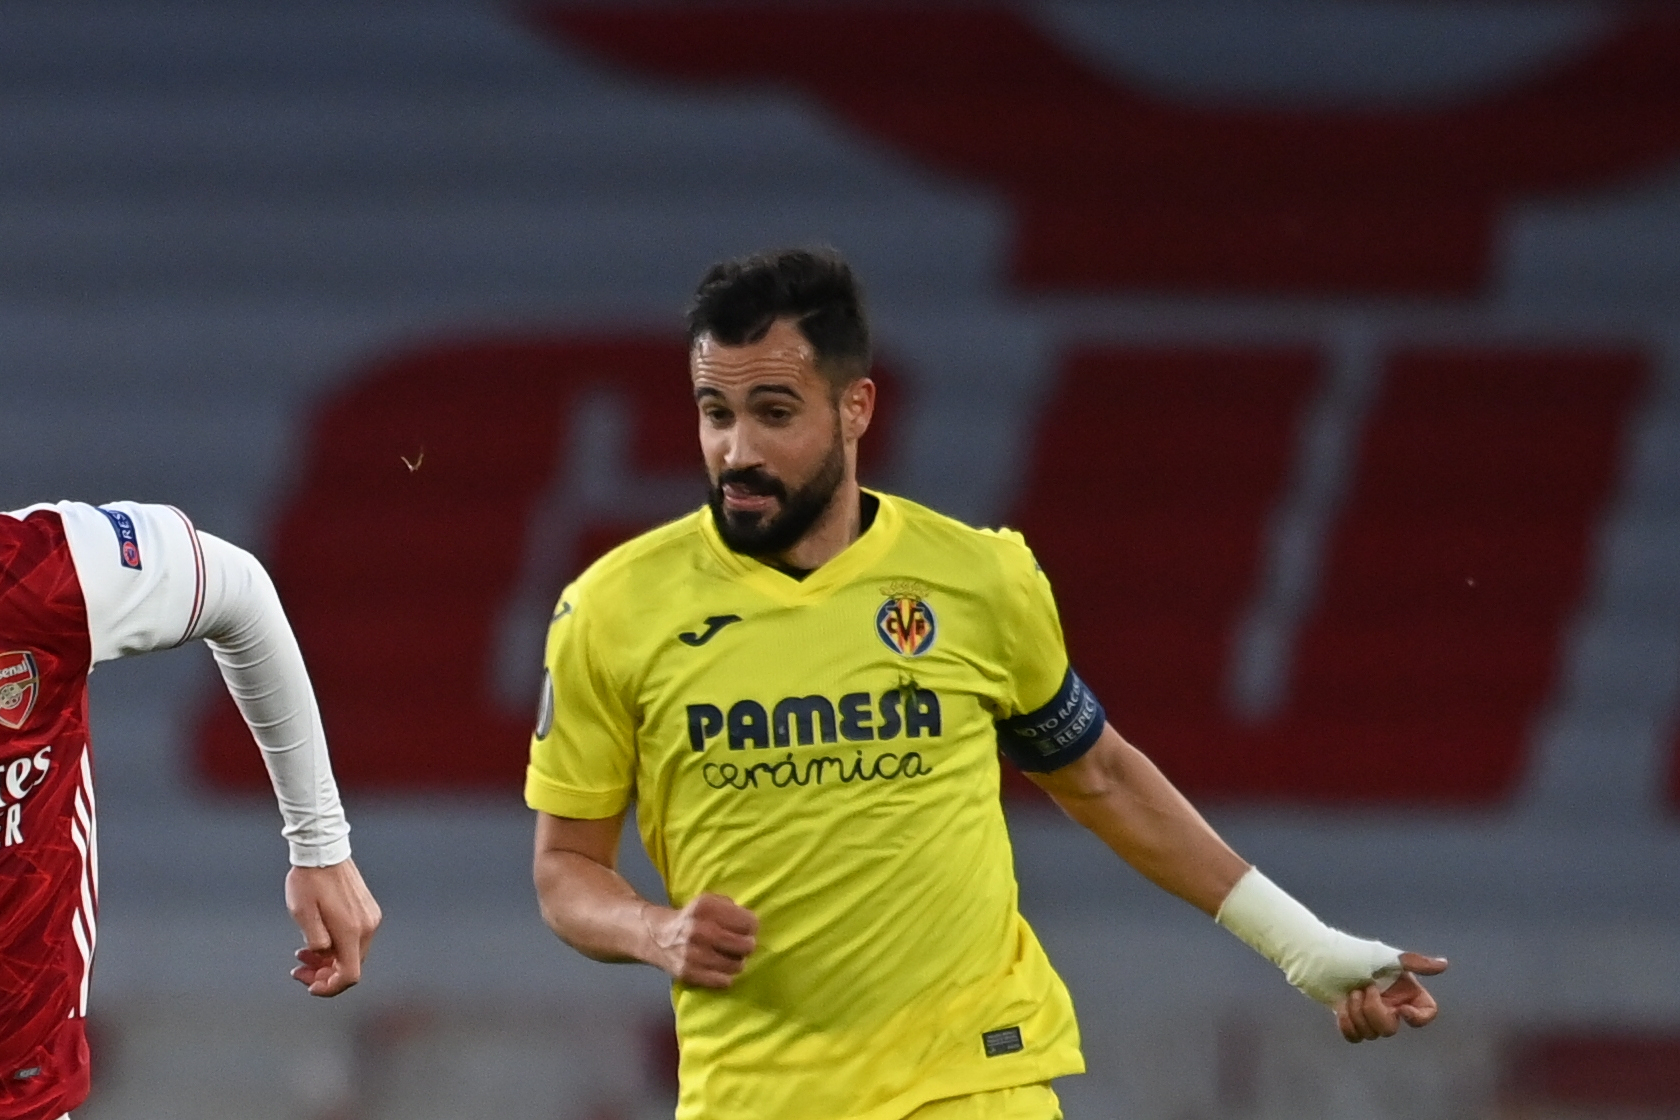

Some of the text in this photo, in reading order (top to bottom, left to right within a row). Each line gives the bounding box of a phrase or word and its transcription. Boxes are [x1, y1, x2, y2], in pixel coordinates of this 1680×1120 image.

[686, 687, 943, 753] PAMESA
[1037, 718, 1059, 733] TO
[702, 750, 933, 790] cerámica
